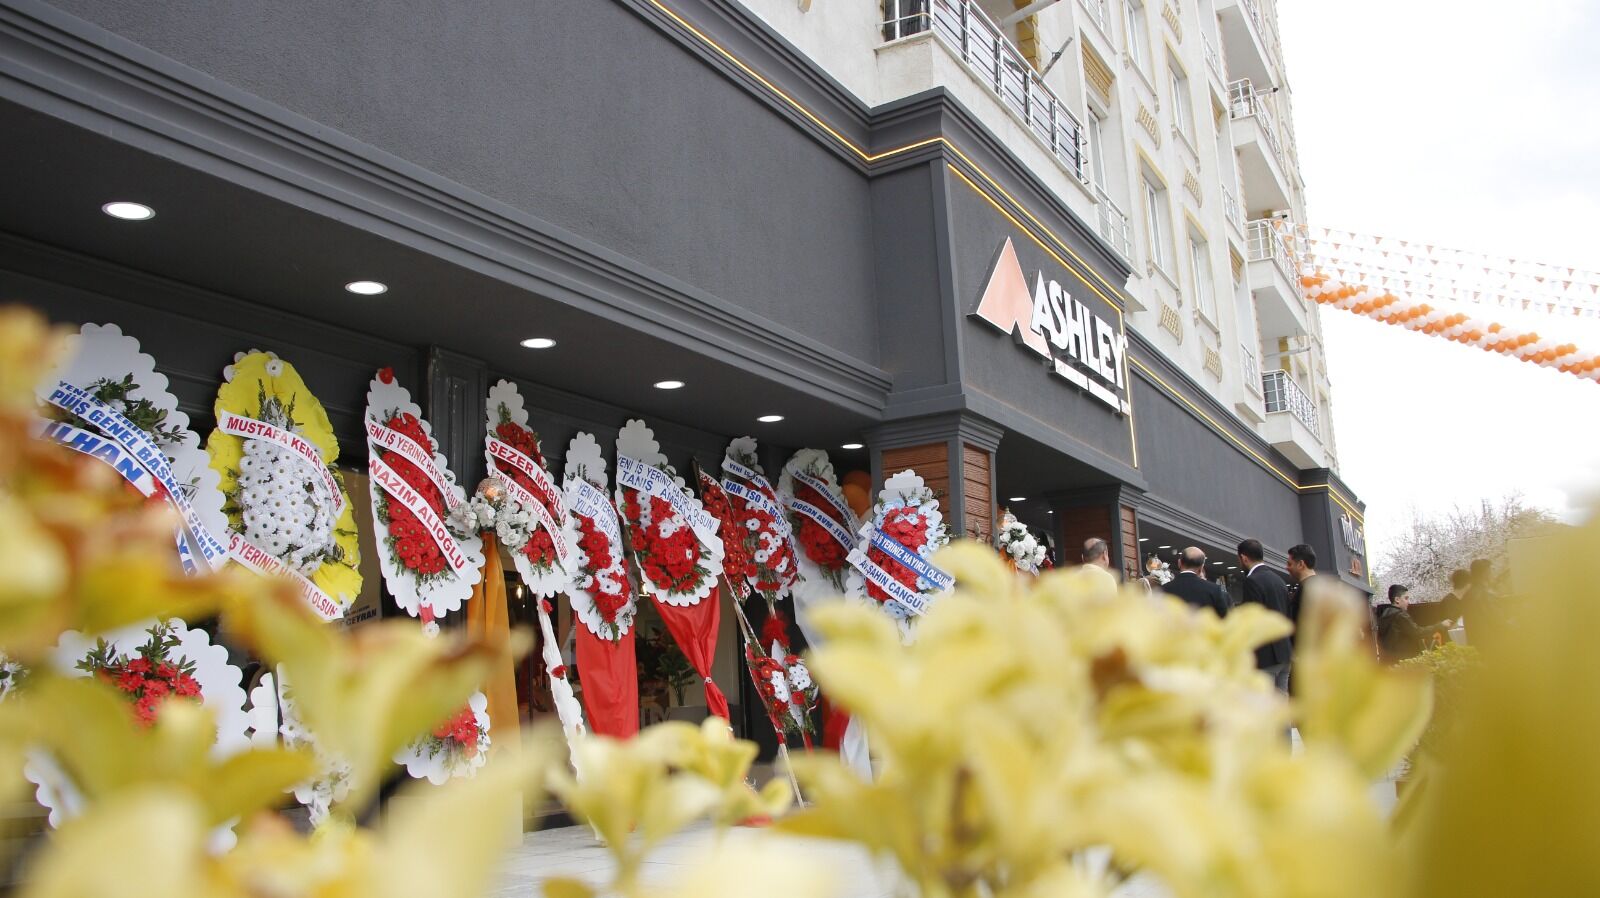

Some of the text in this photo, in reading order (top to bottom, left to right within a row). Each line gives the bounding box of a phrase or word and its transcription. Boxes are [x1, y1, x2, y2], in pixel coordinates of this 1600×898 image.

[1031, 269, 1124, 390] ASHLEY
[88, 409, 139, 450] GENEL
[226, 416, 289, 445] MUSTAFA
[290, 436, 321, 470] KEMAL
[489, 441, 534, 476] SEZER
[370, 459, 418, 506] NAZIM
[725, 481, 743, 495] VAN
[745, 488, 762, 503] TSO
[693, 508, 715, 530] OLSUN
[816, 514, 833, 528] AVM
[902, 552, 930, 575] HAYIRLI
